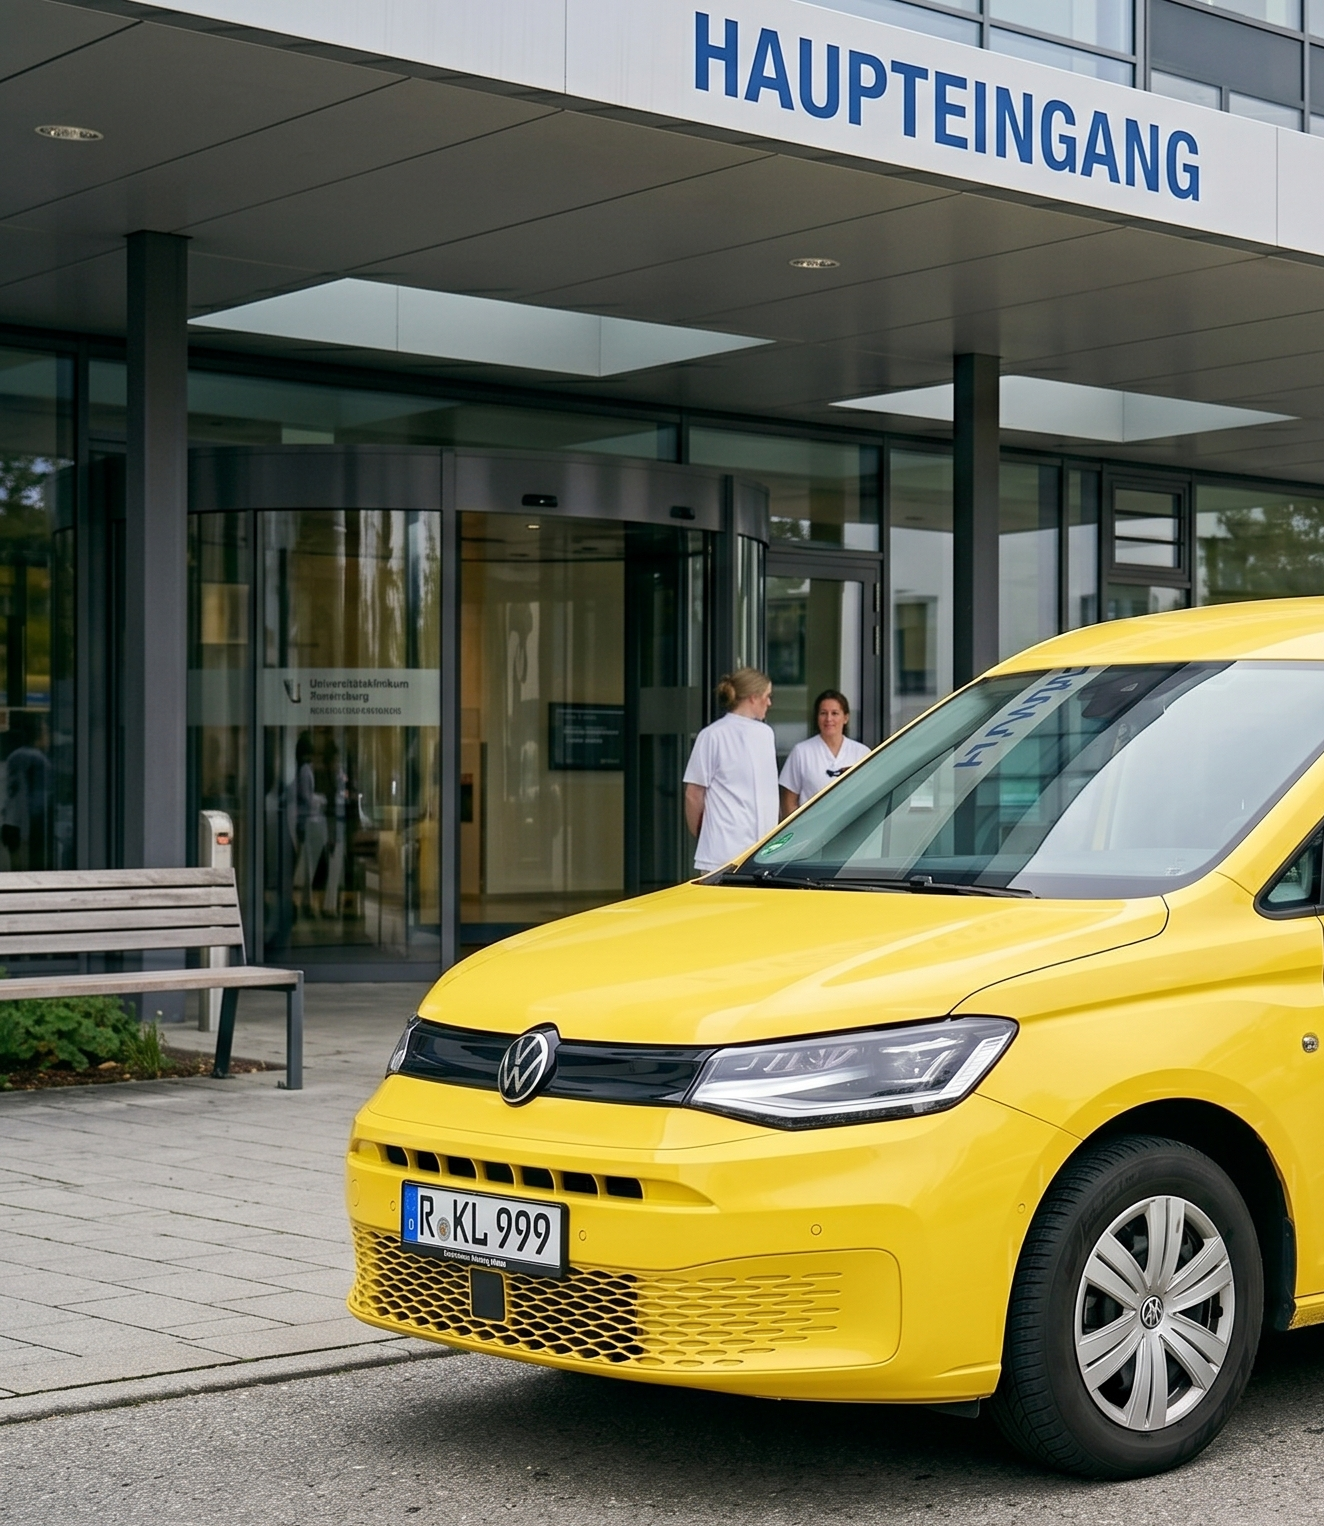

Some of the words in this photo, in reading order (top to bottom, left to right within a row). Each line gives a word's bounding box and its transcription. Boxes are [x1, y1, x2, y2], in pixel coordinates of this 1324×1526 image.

[694, 10, 1200, 202] HAUPTEINGANG
[420, 1194, 435, 1238] R
[453, 1199, 488, 1247] KL
[496, 1207, 551, 1255] 999
